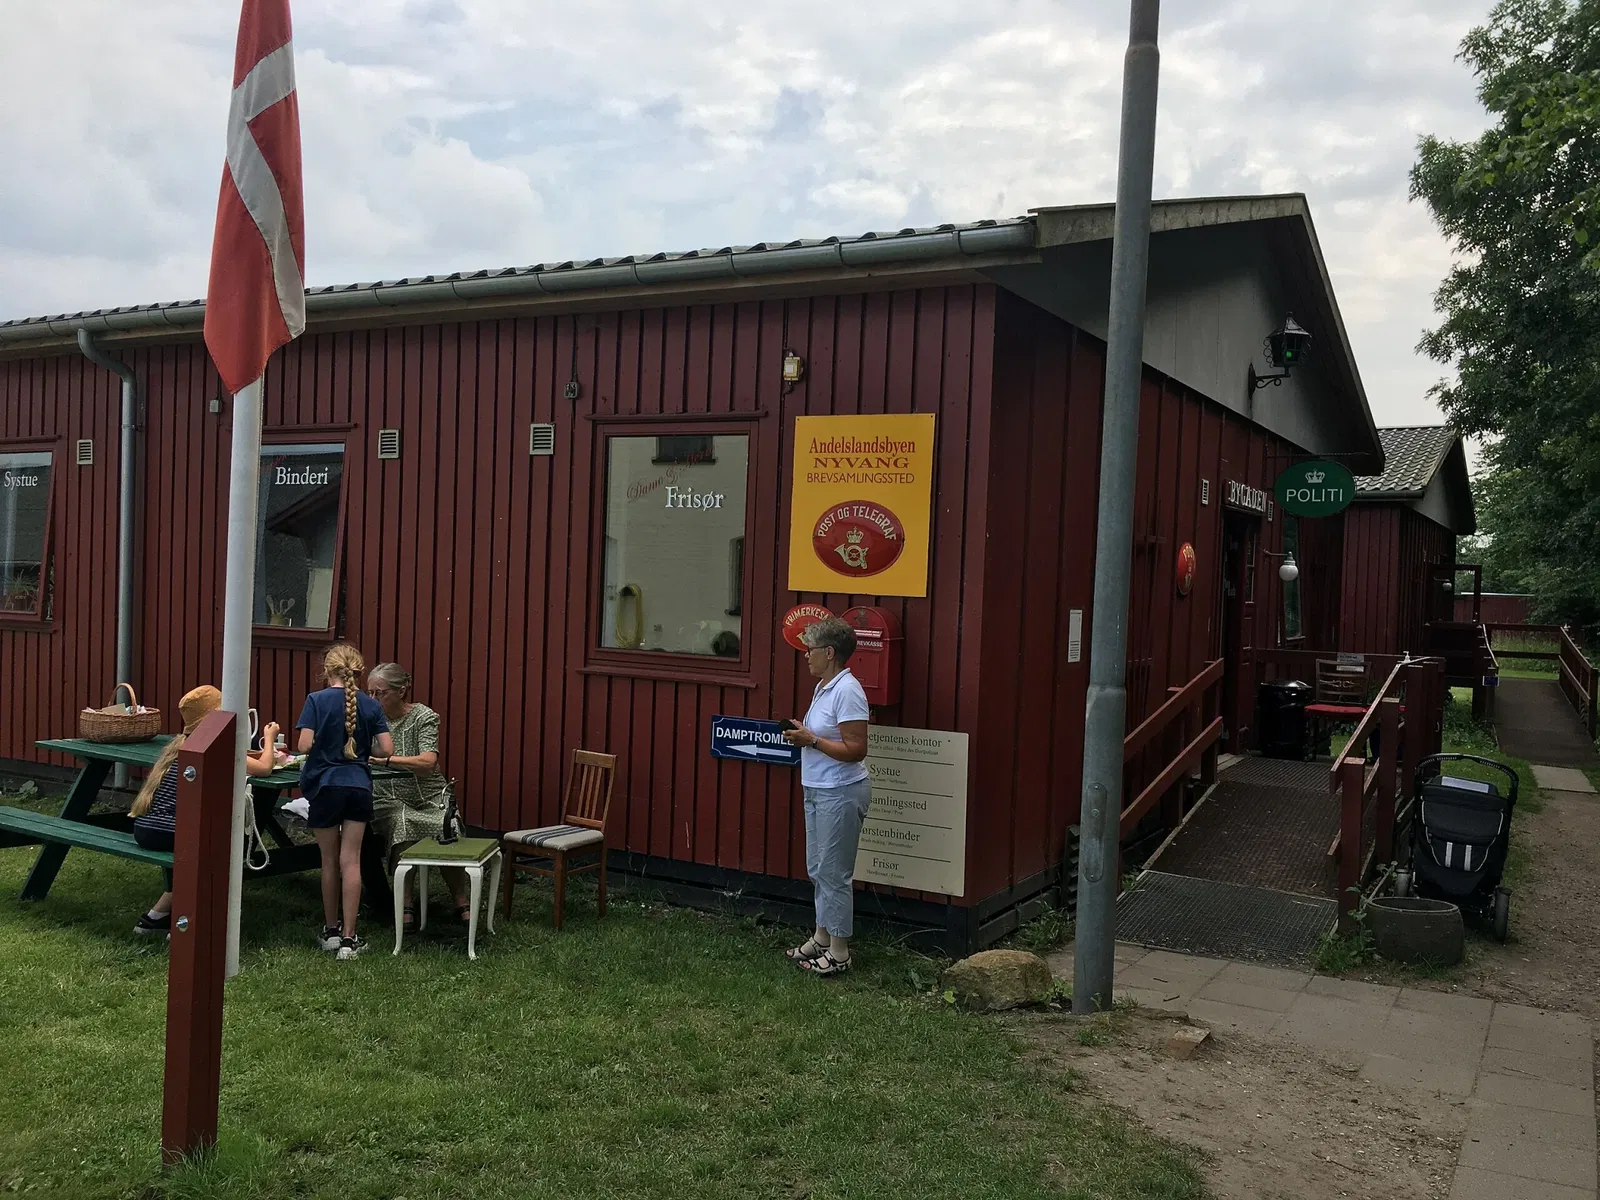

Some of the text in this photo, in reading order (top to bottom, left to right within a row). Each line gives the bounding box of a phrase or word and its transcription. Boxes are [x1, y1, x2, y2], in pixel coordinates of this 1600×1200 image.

[809, 436, 915, 457] Andelslandsbyen
[813, 457, 910, 469] NYVANG
[4, 471, 38, 490] Systue
[275, 466, 329, 485] Binderi
[807, 472, 915, 484] BREVSAMLINGSSTED
[665, 486, 724, 511] Frisør
[1228, 480, 1267, 512] BYGADEN
[1286, 488, 1343, 502] POLITI
[817, 505, 897, 541] POST OG TELEGRAF
[856, 640, 883, 648] REVKASSE
[868, 732, 943, 748] etjentens kontor
[870, 764, 901, 778] Systue
[869, 796, 927, 811] samlingssted
[862, 827, 921, 842] ørstenbinder
[872, 857, 900, 871] Frisør
